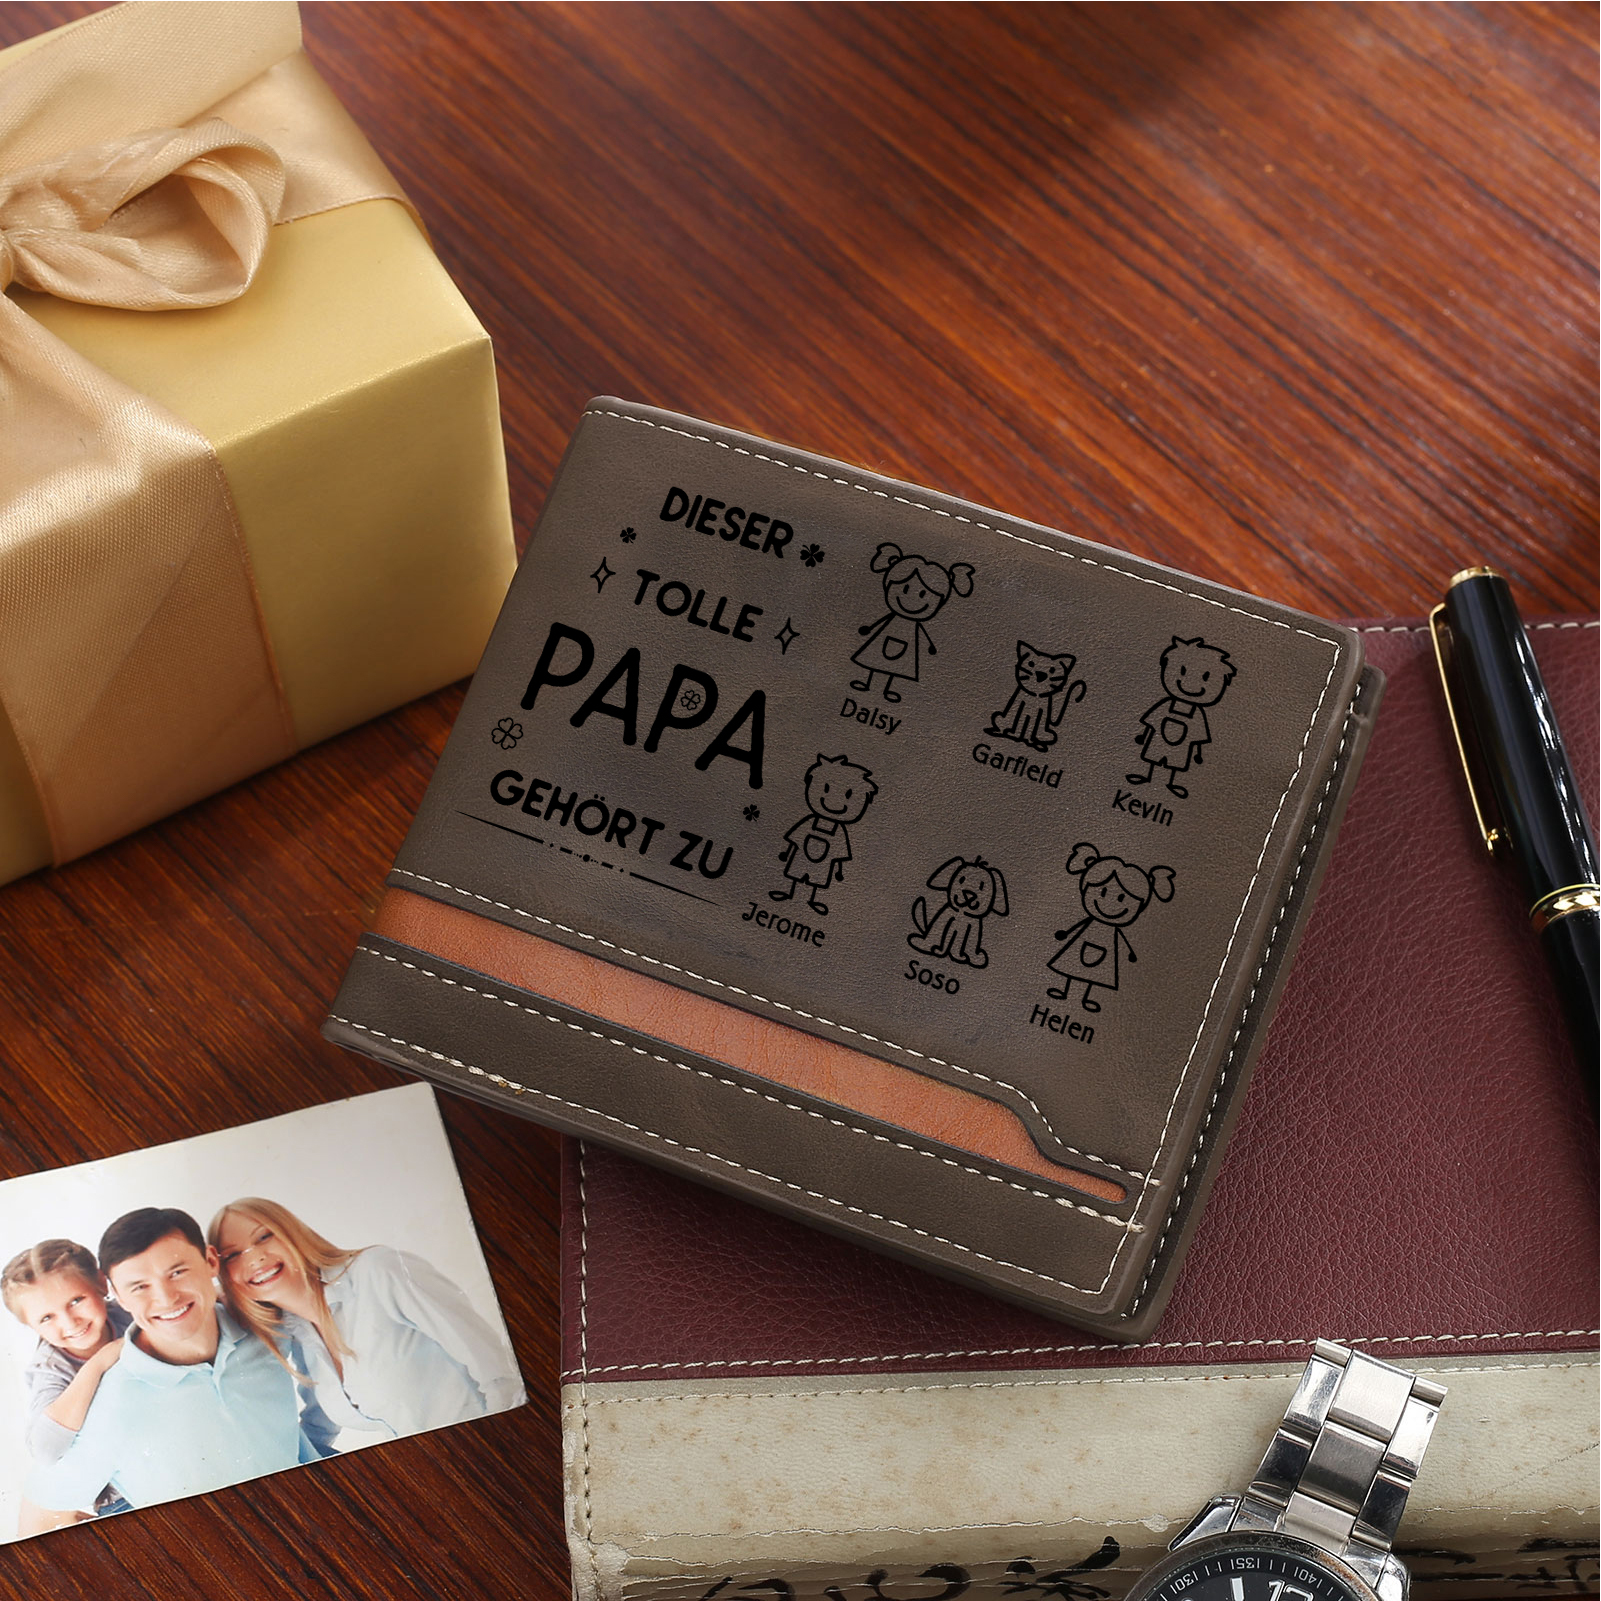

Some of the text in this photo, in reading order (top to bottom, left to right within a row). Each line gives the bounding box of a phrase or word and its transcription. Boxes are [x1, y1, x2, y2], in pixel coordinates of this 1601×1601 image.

[659, 486, 795, 559] DIESER
[634, 568, 764, 643] TOLLE
[519, 621, 767, 791] PAPA
[489, 769, 734, 880] GEHÖRT ZU
[741, 901, 826, 948] Jerome
[903, 959, 961, 995] Soso
[1029, 1003, 1095, 1045] Helen
